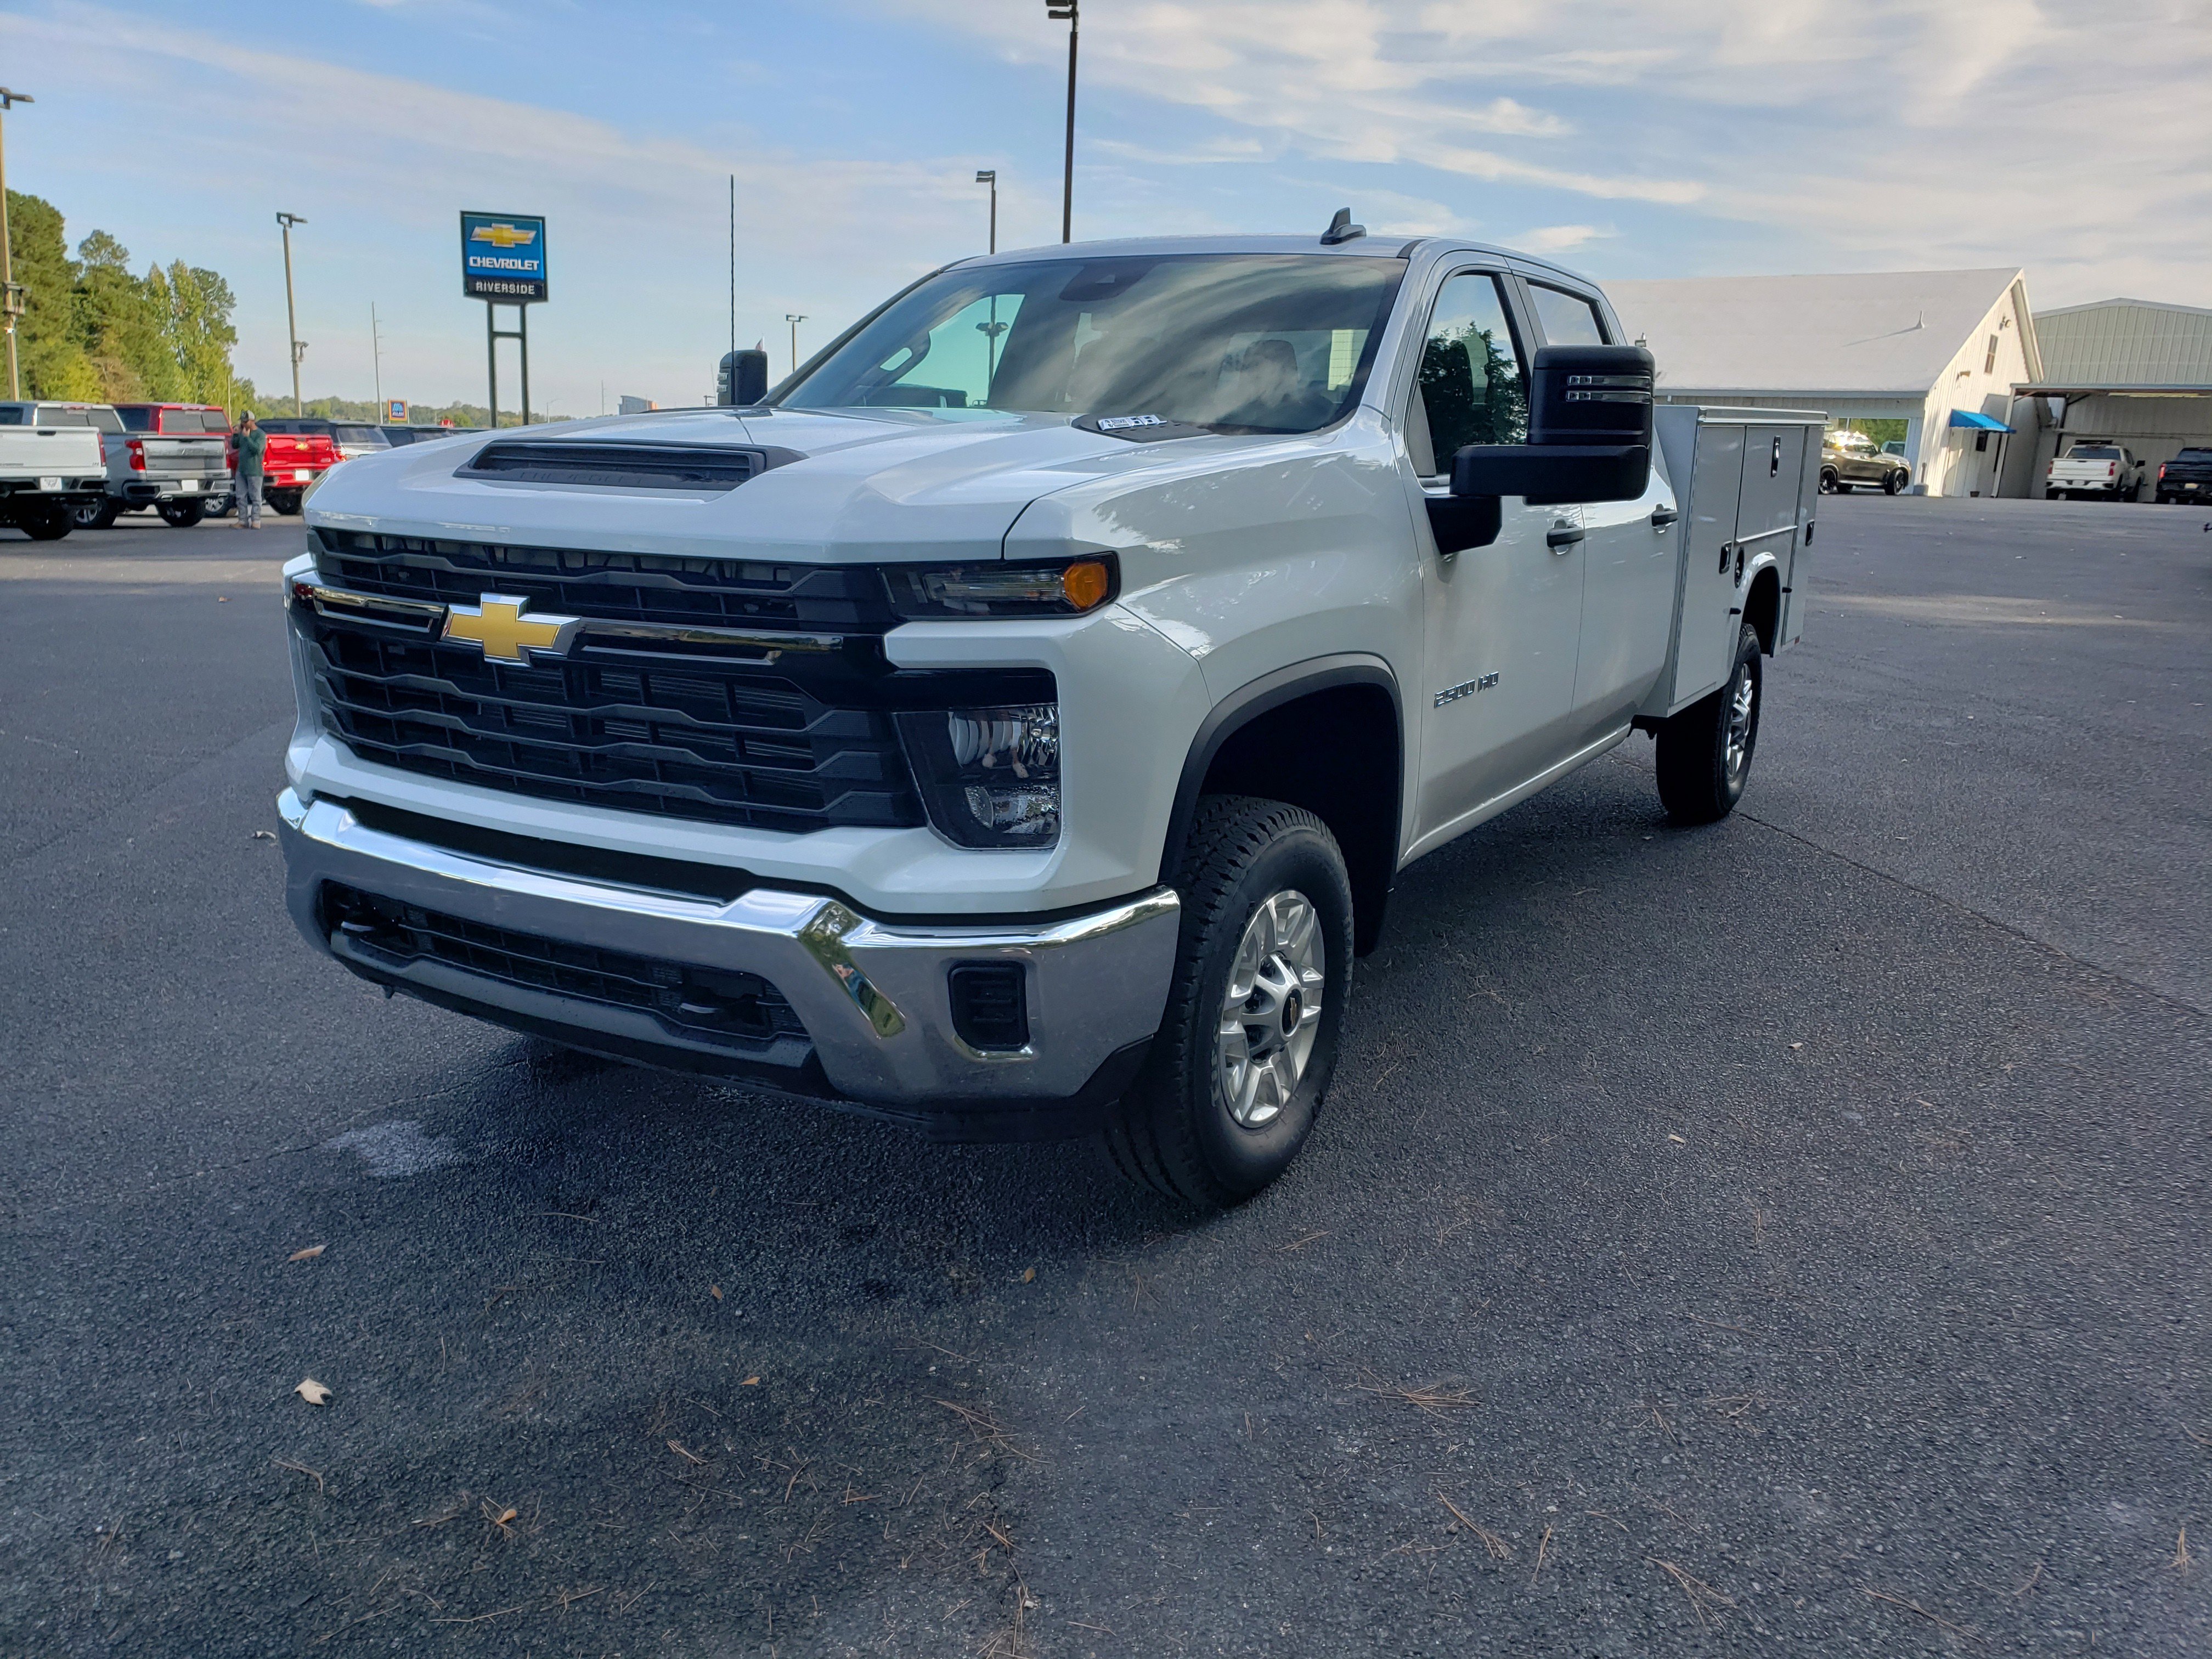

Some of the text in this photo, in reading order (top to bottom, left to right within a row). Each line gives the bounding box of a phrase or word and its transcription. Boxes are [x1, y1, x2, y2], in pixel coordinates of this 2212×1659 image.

[469, 256, 539, 270] CHEVROLET
[476, 281, 535, 295] RIVERSIDE
[1434, 671, 1499, 709] 2500 HD
